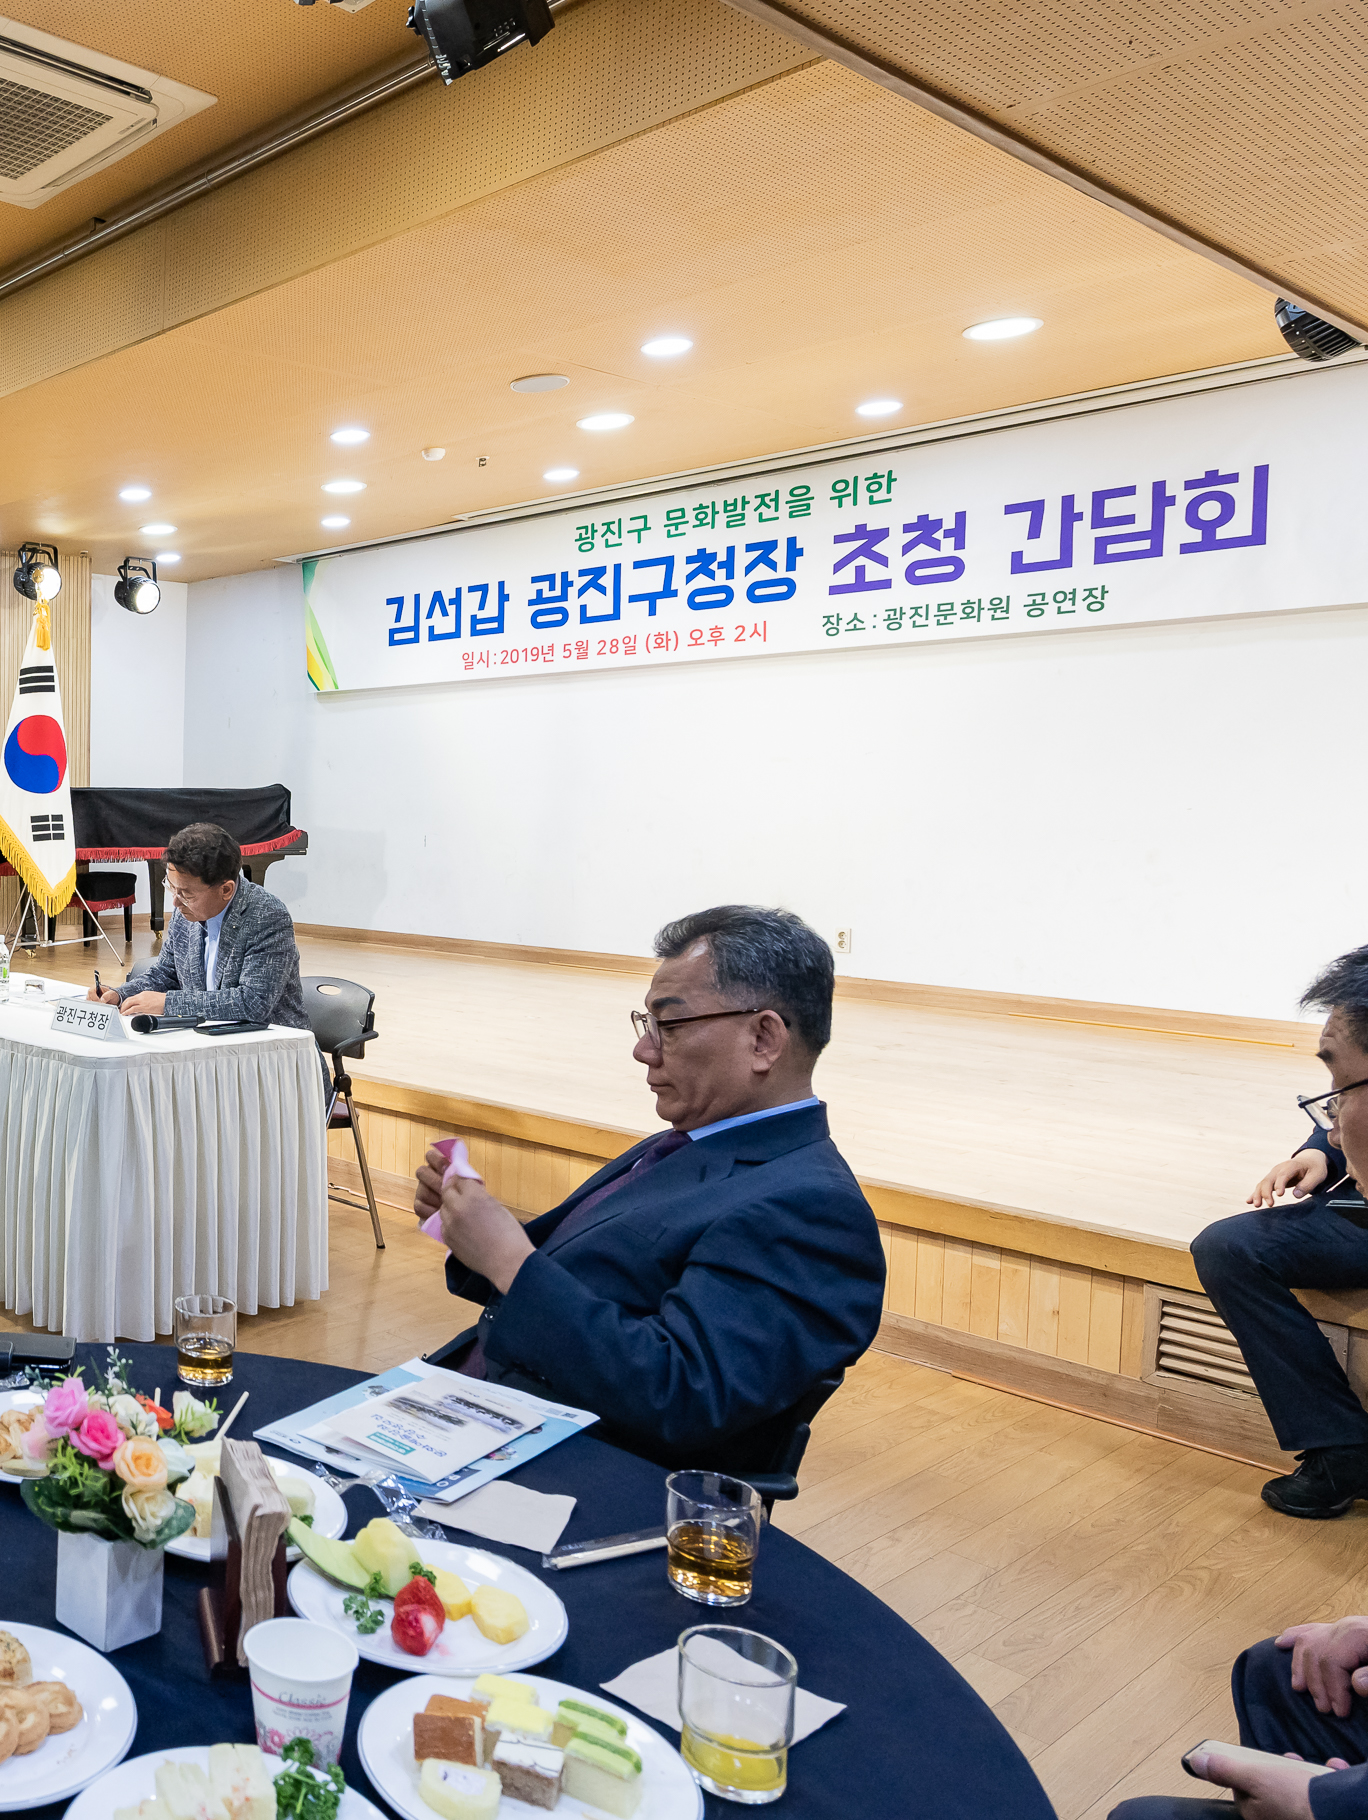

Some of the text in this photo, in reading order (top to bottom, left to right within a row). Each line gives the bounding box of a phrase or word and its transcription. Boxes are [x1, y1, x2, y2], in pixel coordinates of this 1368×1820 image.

[574, 469, 898, 553] 광진구 문화발전을 위한
[386, 464, 1269, 647] 김선갑 광진구청장 초청 간담회
[1023, 584, 1109, 619] 공연장
[562, 639, 589, 660] 5월
[596, 634, 637, 656] 28일
[645, 629, 680, 654] (화)
[687, 625, 726, 648] 오후
[733, 620, 767, 643] 2시
[56, 1005, 109, 1031] 광진구청장
